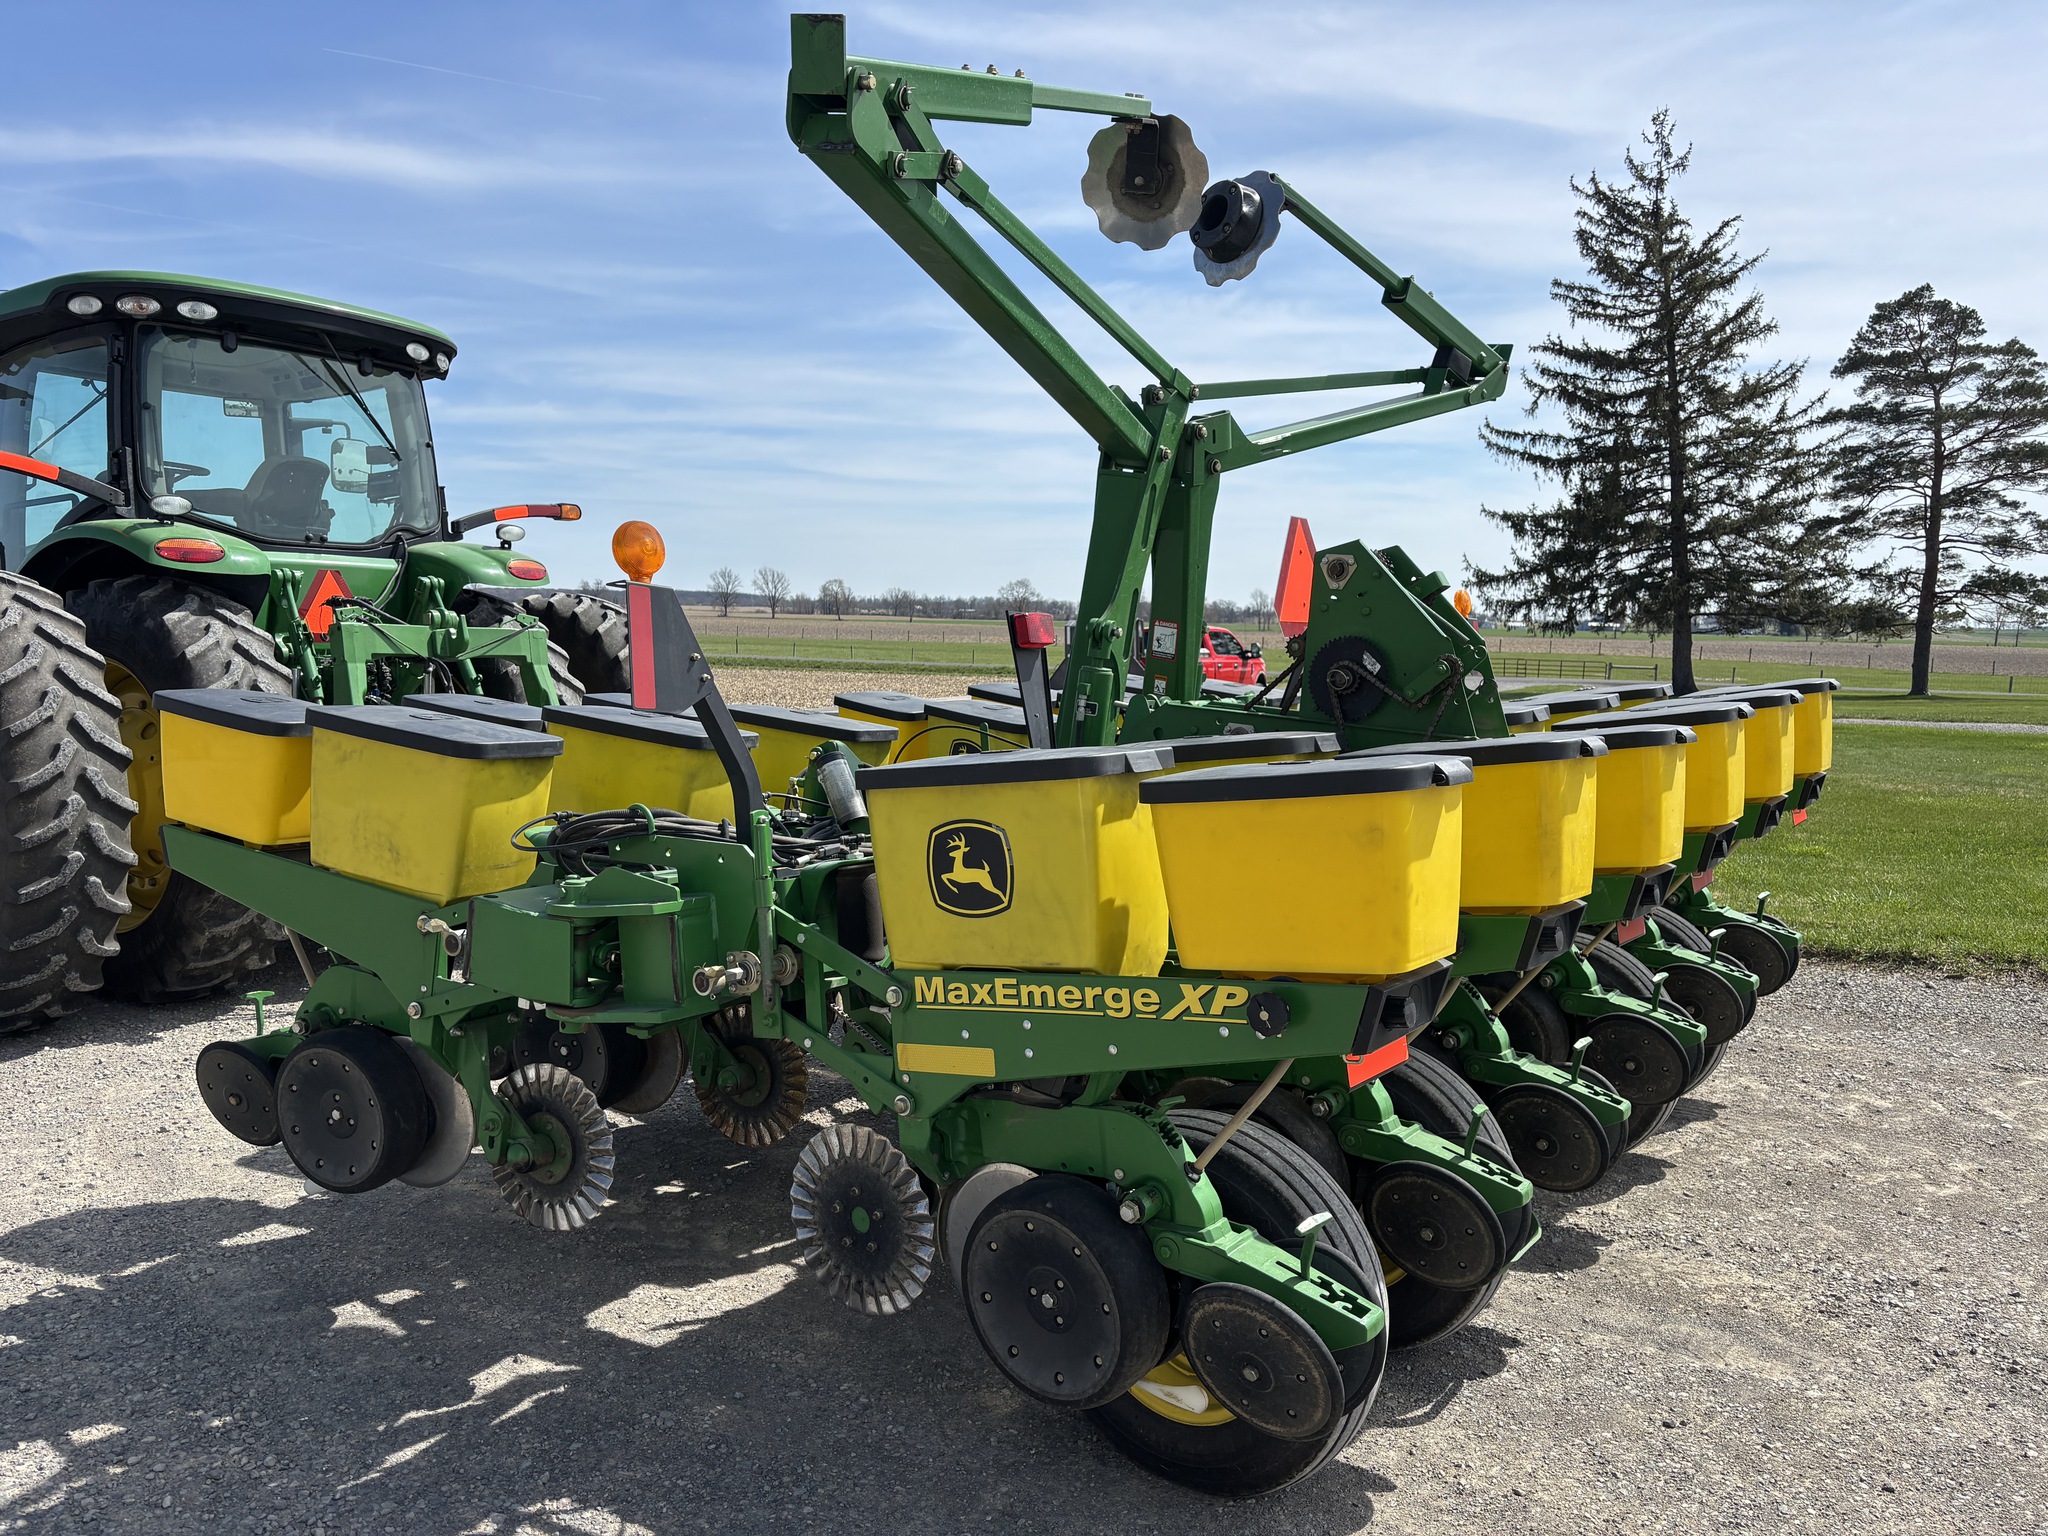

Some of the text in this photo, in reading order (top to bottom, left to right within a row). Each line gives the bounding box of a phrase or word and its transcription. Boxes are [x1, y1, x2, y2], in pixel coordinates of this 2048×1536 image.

[1160, 620, 1178, 629] DANGER
[914, 976, 1250, 1021] MaxEmerge XP
